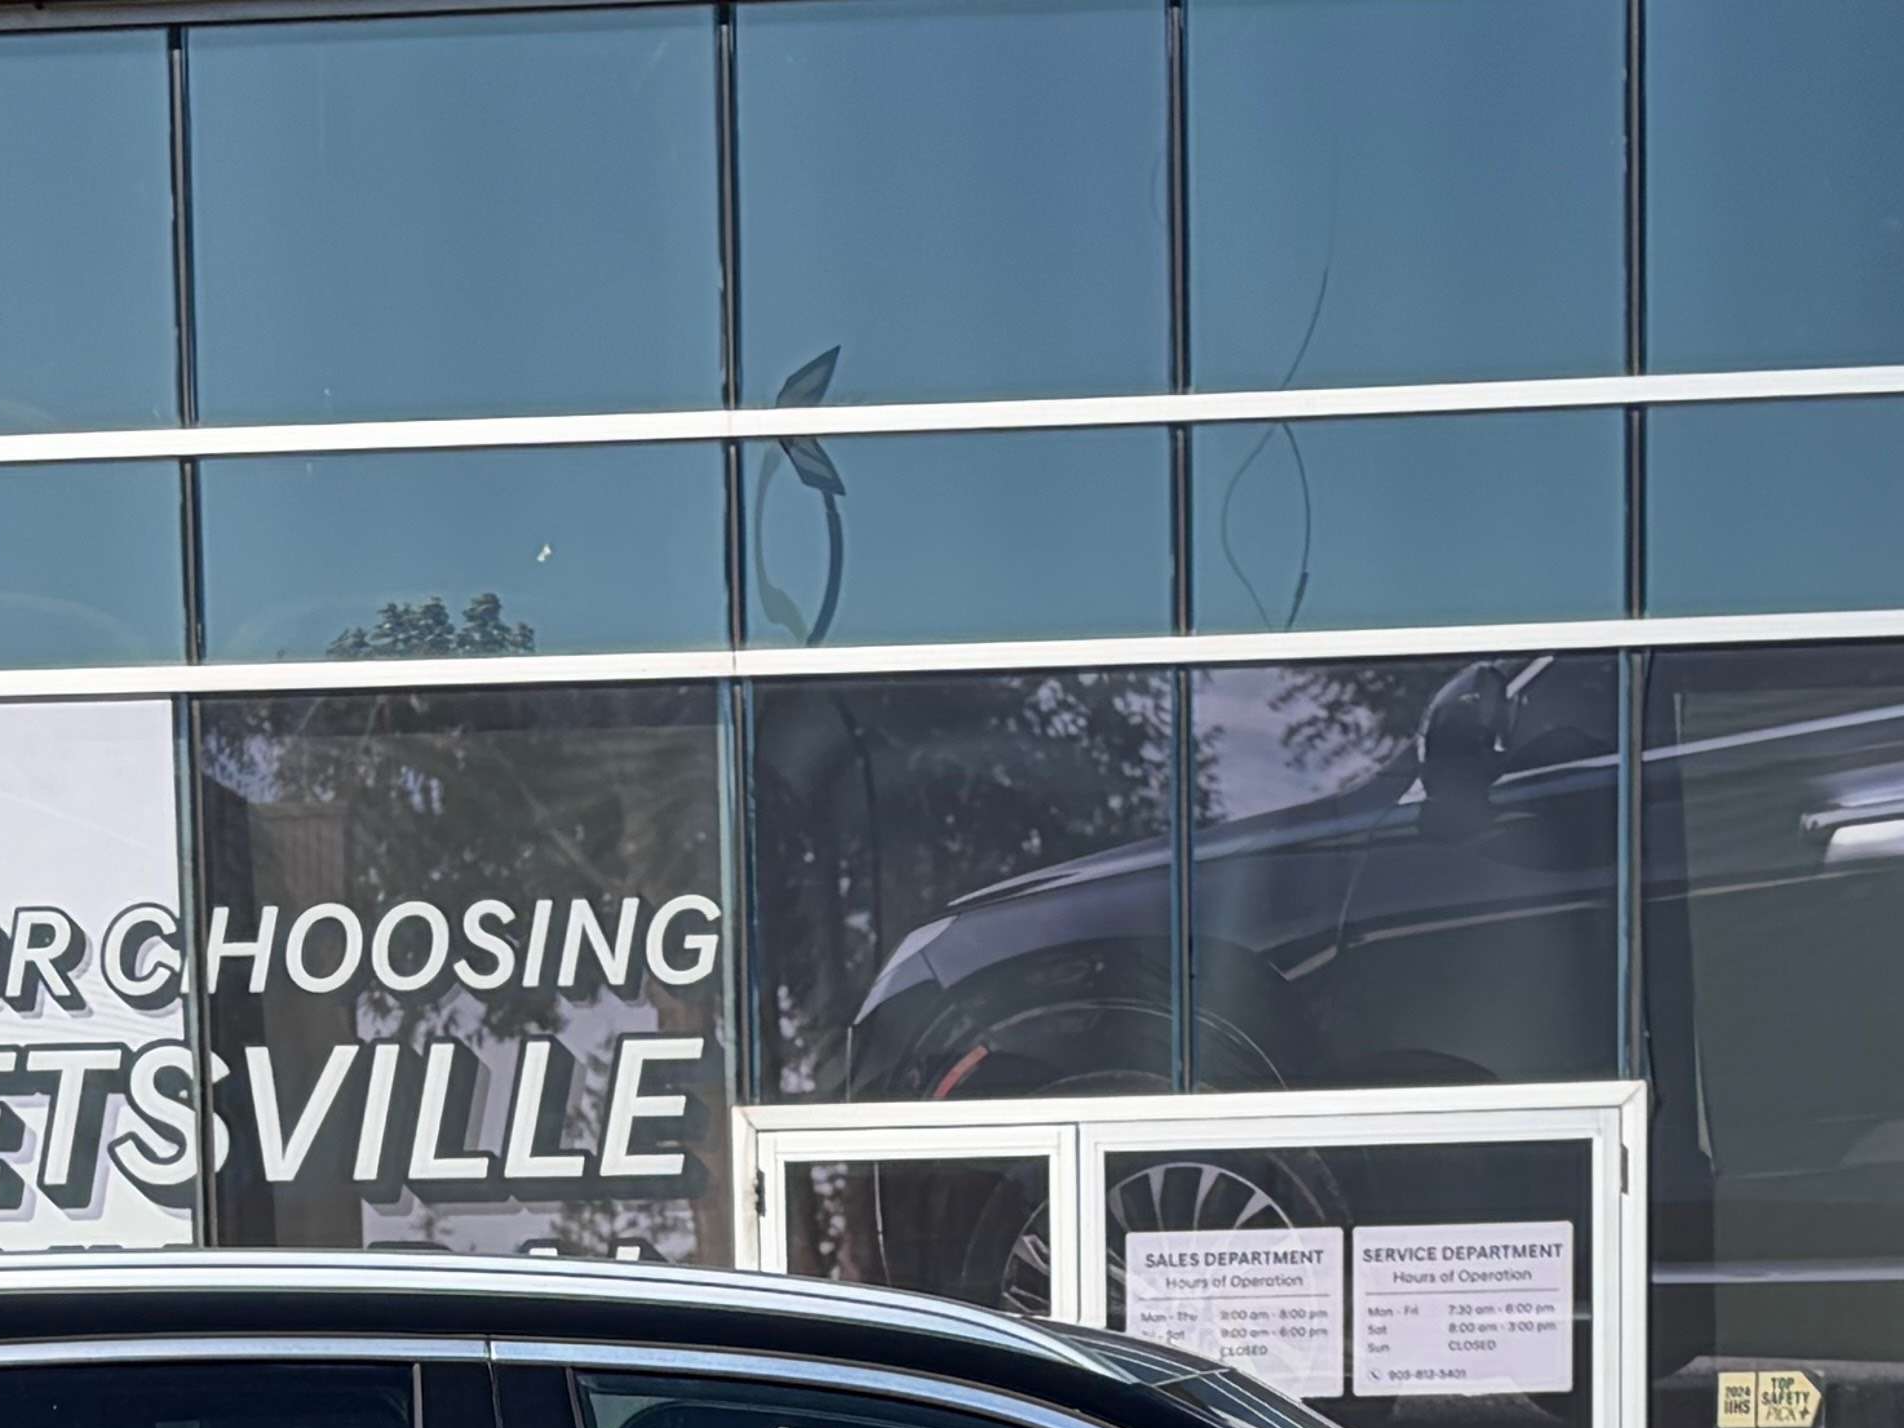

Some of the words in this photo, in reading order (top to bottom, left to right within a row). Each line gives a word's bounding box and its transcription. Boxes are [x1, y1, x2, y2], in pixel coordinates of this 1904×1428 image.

[100, 894, 723, 1008] CHOOSING
[1145, 1252, 1200, 1268] SALES
[1204, 1249, 1325, 1266] DEPARTMENT
[1362, 1246, 1437, 1263] SERVICE
[1442, 1243, 1564, 1261] DEPARTMENT
[1165, 1277, 1208, 1290] Hours
[1212, 1275, 1226, 1288] of
[1230, 1274, 1304, 1290] Operation
[1393, 1271, 1436, 1284] Hours
[1440, 1269, 1455, 1283] of
[1458, 1268, 1533, 1284] Operation
[1448, 1340, 1497, 1352] CLOSED
[1771, 1377, 1795, 1391] TOP
[1762, 1391, 1810, 1407] SAFETY
